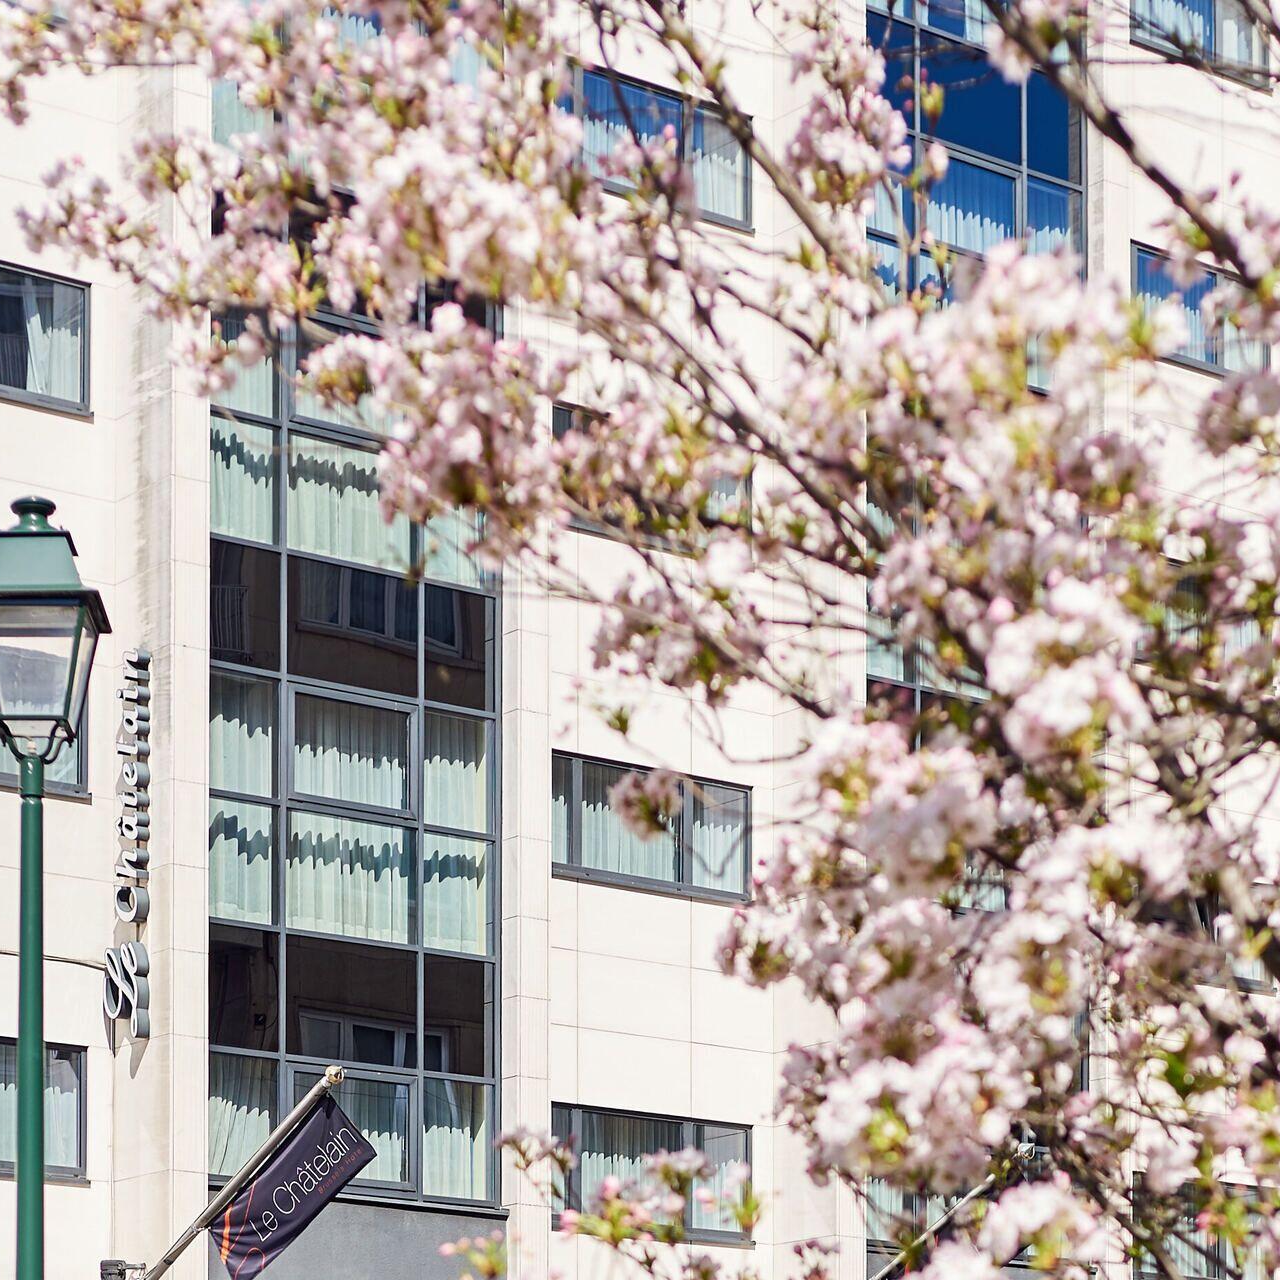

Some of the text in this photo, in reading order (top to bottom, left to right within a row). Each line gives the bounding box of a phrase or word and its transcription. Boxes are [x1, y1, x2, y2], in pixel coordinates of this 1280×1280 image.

[104, 648, 146, 1038] Le Châtelain
[250, 1127, 357, 1242] Le Châtelain
